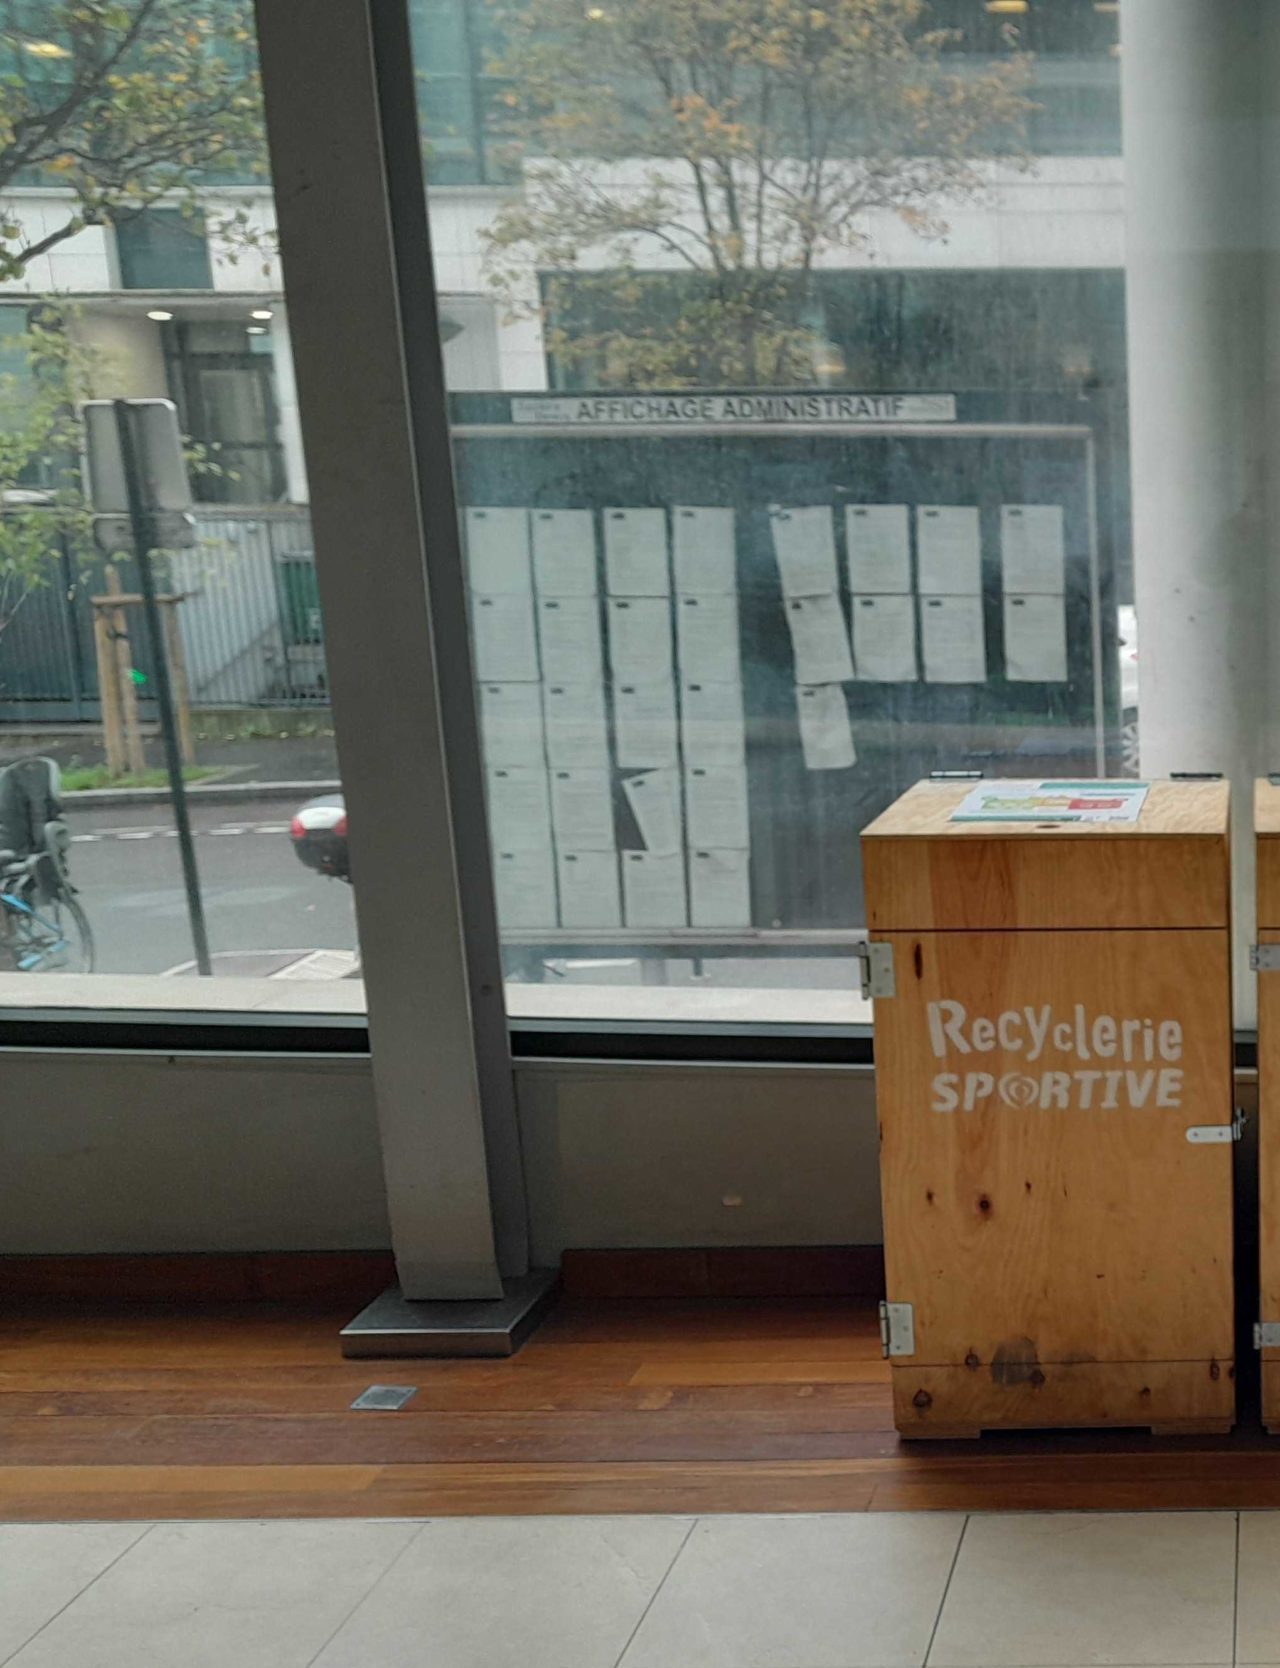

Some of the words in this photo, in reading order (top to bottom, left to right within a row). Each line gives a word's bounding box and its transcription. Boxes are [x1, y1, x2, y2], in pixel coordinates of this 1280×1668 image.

[577, 399, 713, 419] AFFICHAGE
[721, 397, 904, 418] ADMINISTRATIF
[930, 1067, 1184, 1112] SPORTIVE
